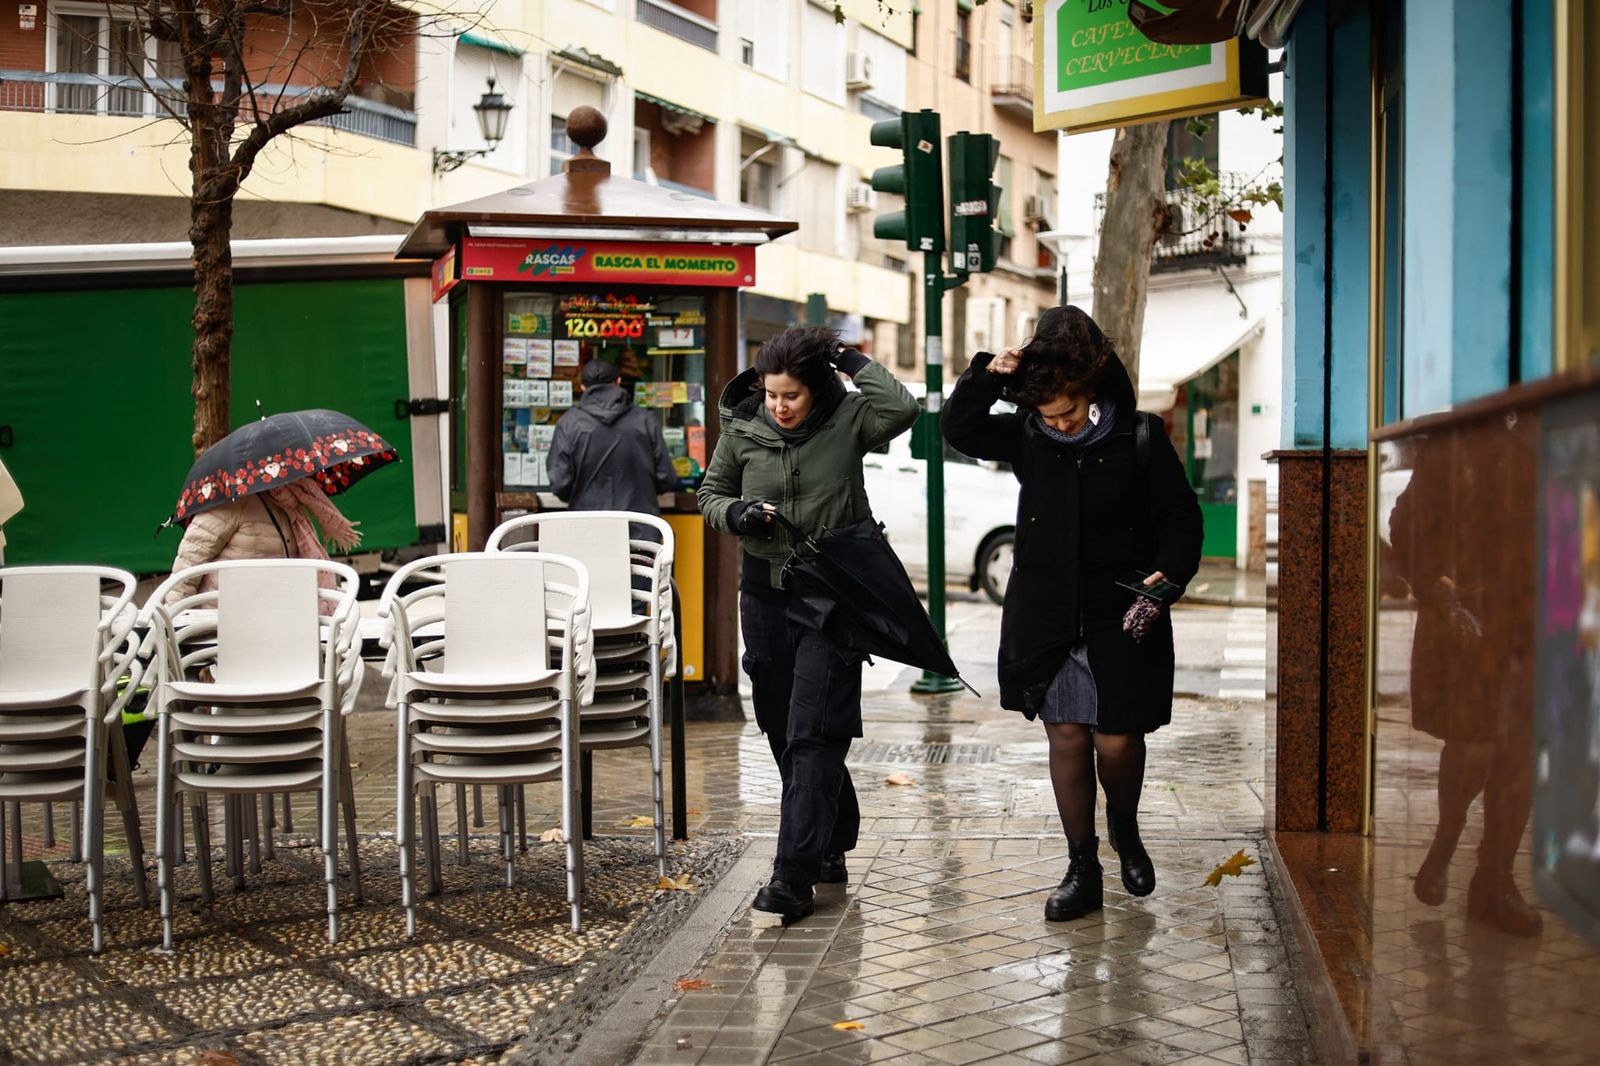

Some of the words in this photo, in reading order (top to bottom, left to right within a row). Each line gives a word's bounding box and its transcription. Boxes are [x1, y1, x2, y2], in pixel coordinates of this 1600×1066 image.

[525, 253, 576, 265] RASCAS
[595, 255, 642, 268] RASCA
[646, 257, 661, 269] EL
[664, 258, 736, 272] MOMENTO
